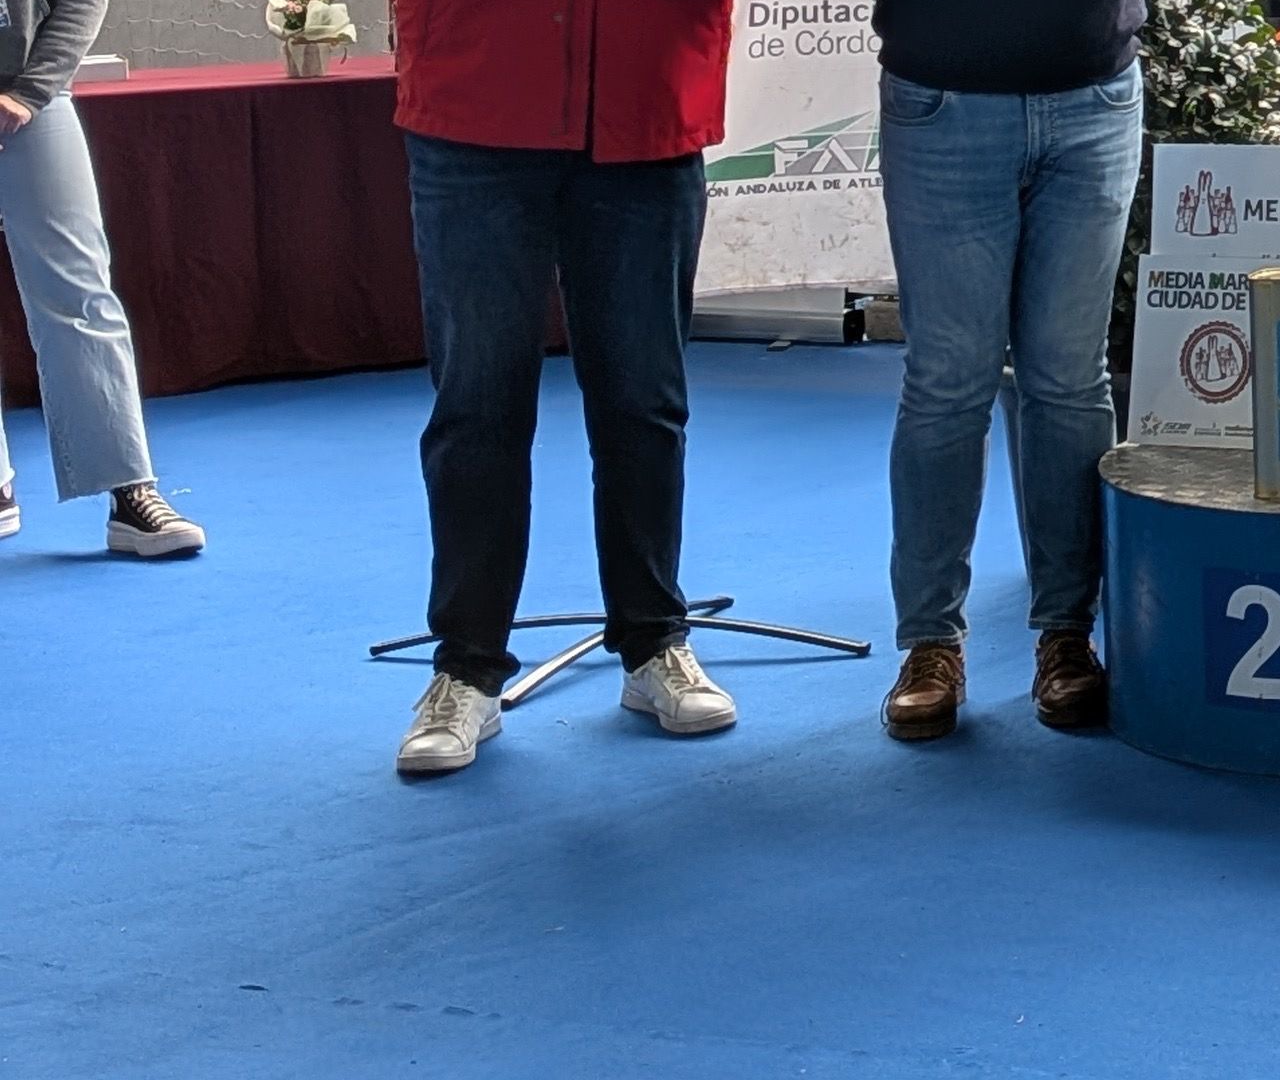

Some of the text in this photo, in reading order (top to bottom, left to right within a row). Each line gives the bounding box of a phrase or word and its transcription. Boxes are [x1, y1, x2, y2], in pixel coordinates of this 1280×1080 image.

[749, 0, 877, 30] Diputac
[748, 30, 882, 58] de Córdo
[736, 180, 817, 196] ANDALUZA
[823, 179, 841, 190] DE
[1149, 270, 1250, 291] MEDIA MAR
[1147, 290, 1246, 311] CIUDAD DE
